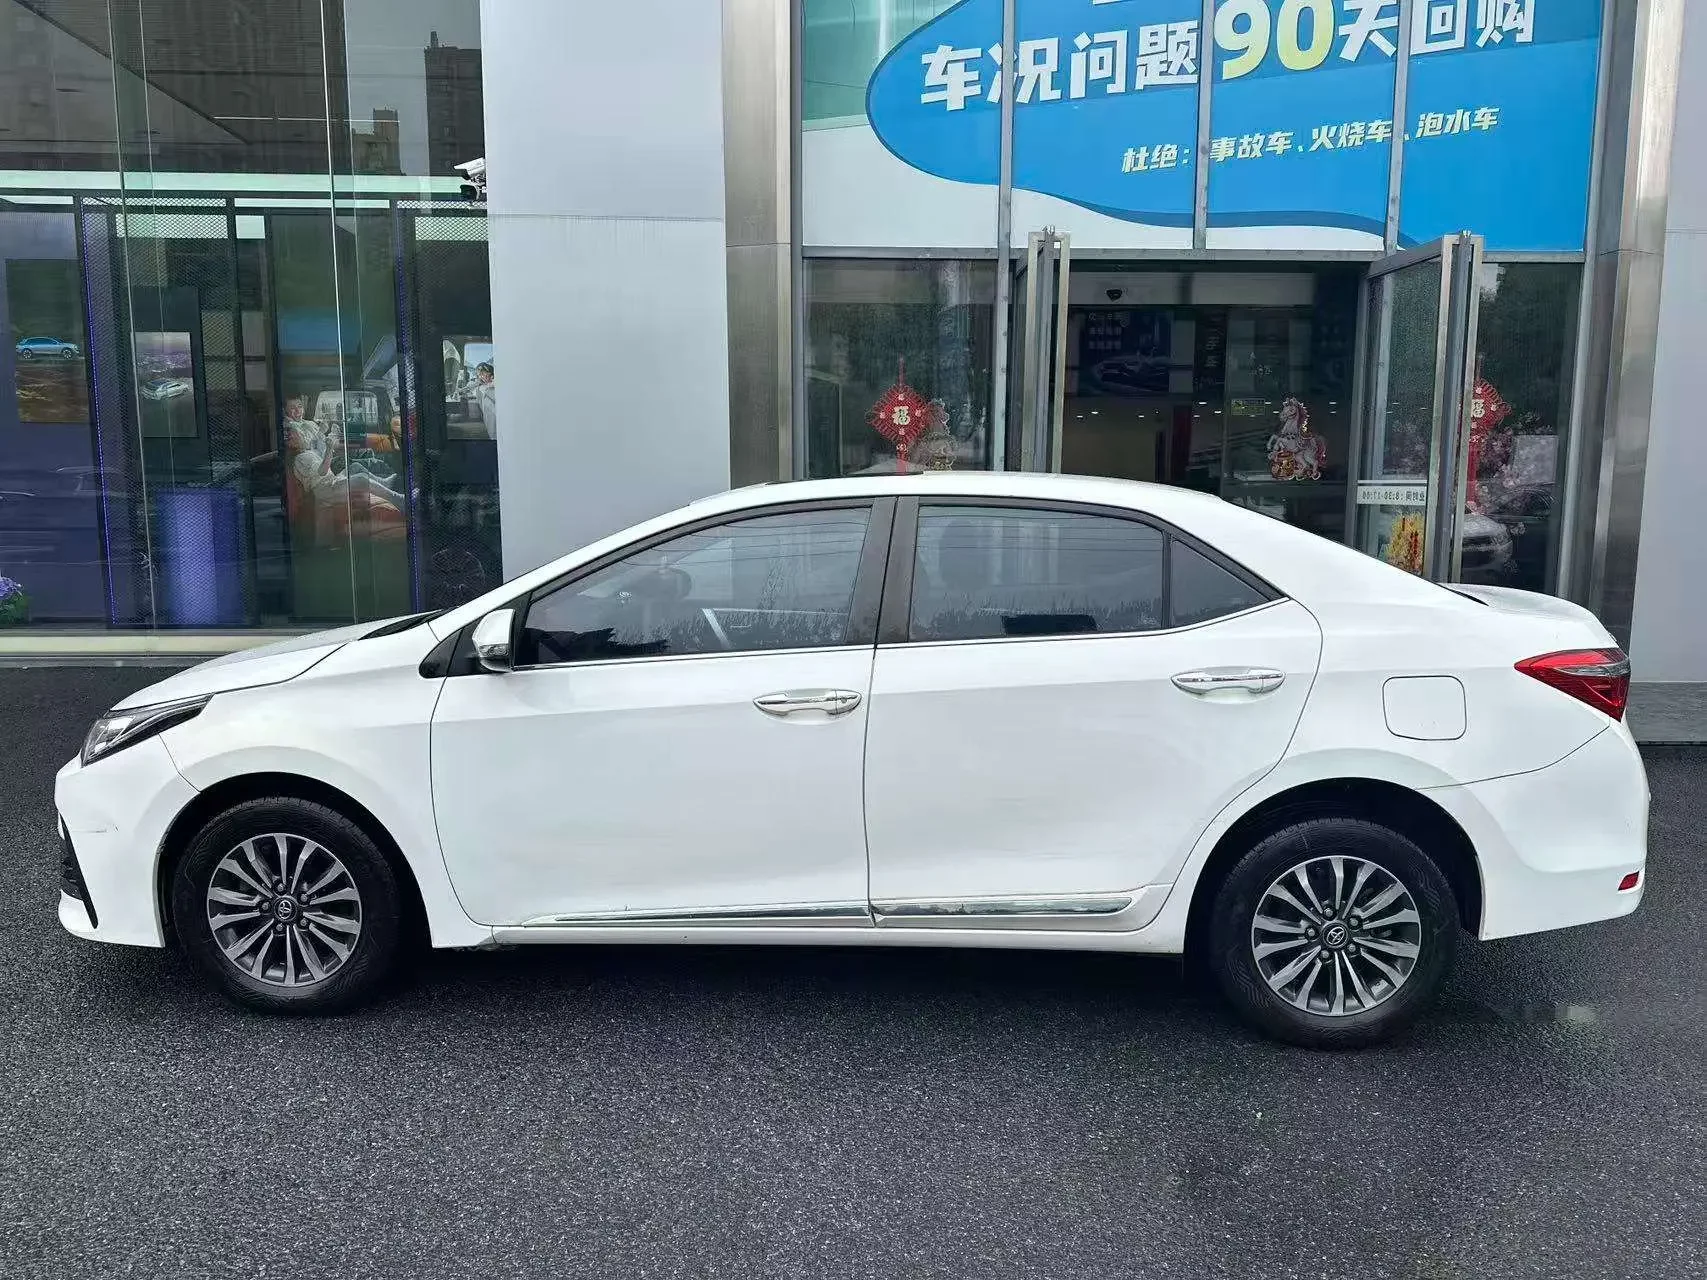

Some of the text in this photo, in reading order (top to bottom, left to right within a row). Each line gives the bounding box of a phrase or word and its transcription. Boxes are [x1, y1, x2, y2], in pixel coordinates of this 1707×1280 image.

[920, 0, 1537, 111] 车况问题90天回购
[892, 405, 911, 425] 福
